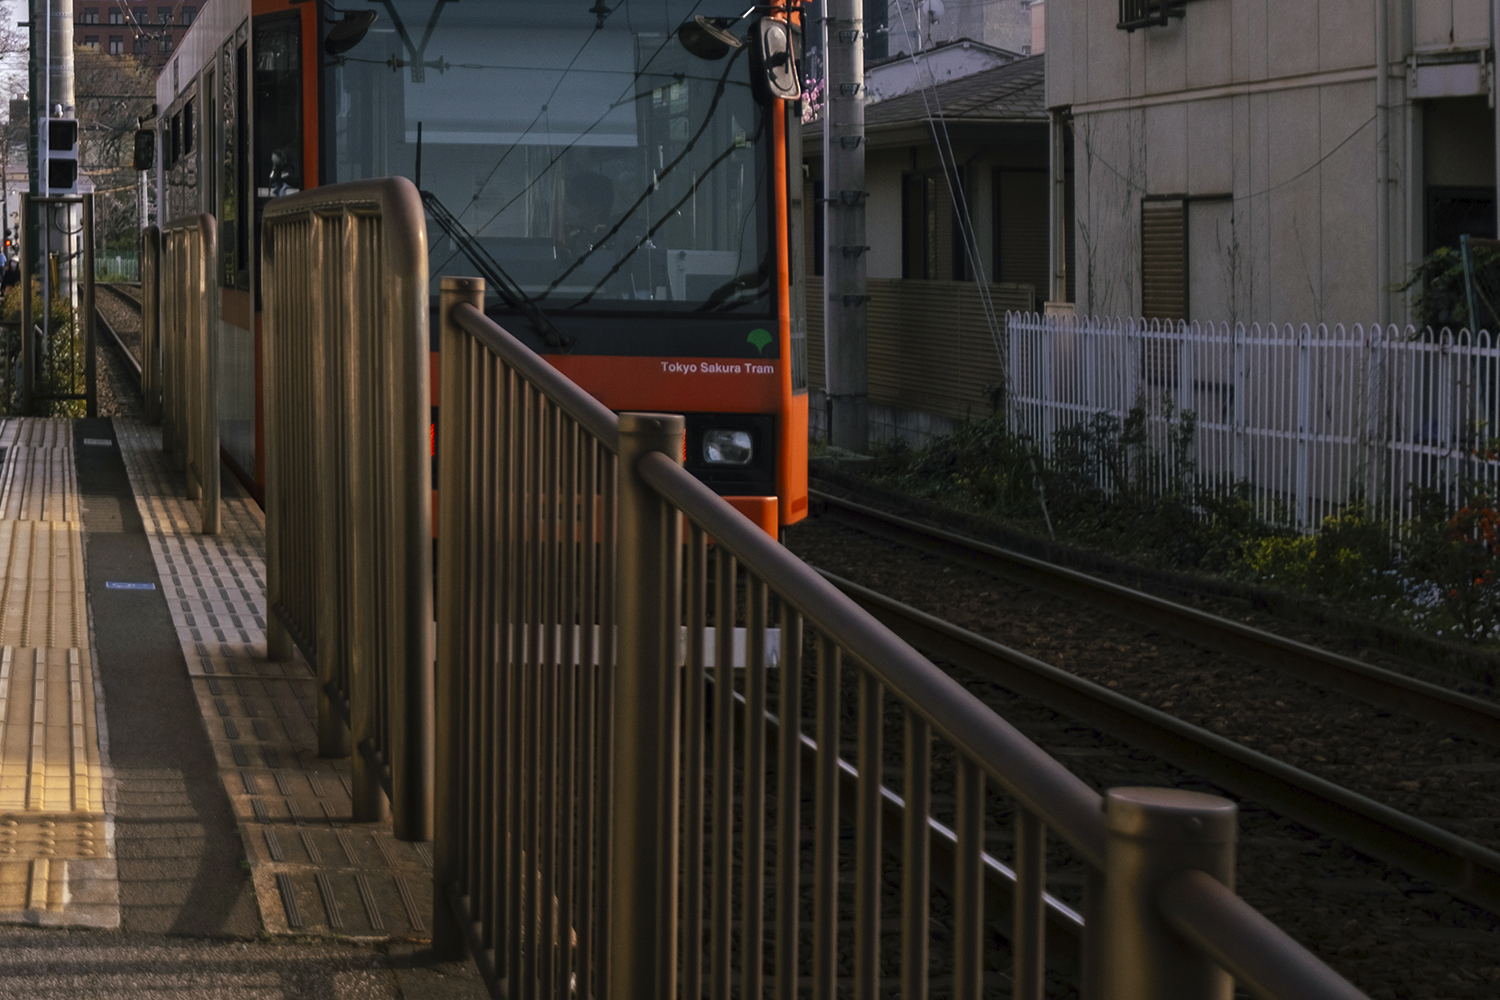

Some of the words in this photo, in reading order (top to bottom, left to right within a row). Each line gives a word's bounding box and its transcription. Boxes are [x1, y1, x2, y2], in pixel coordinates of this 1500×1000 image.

[661, 361, 698, 375] Tokyo
[700, 362, 741, 374] Sakura
[744, 362, 774, 374] Tram
